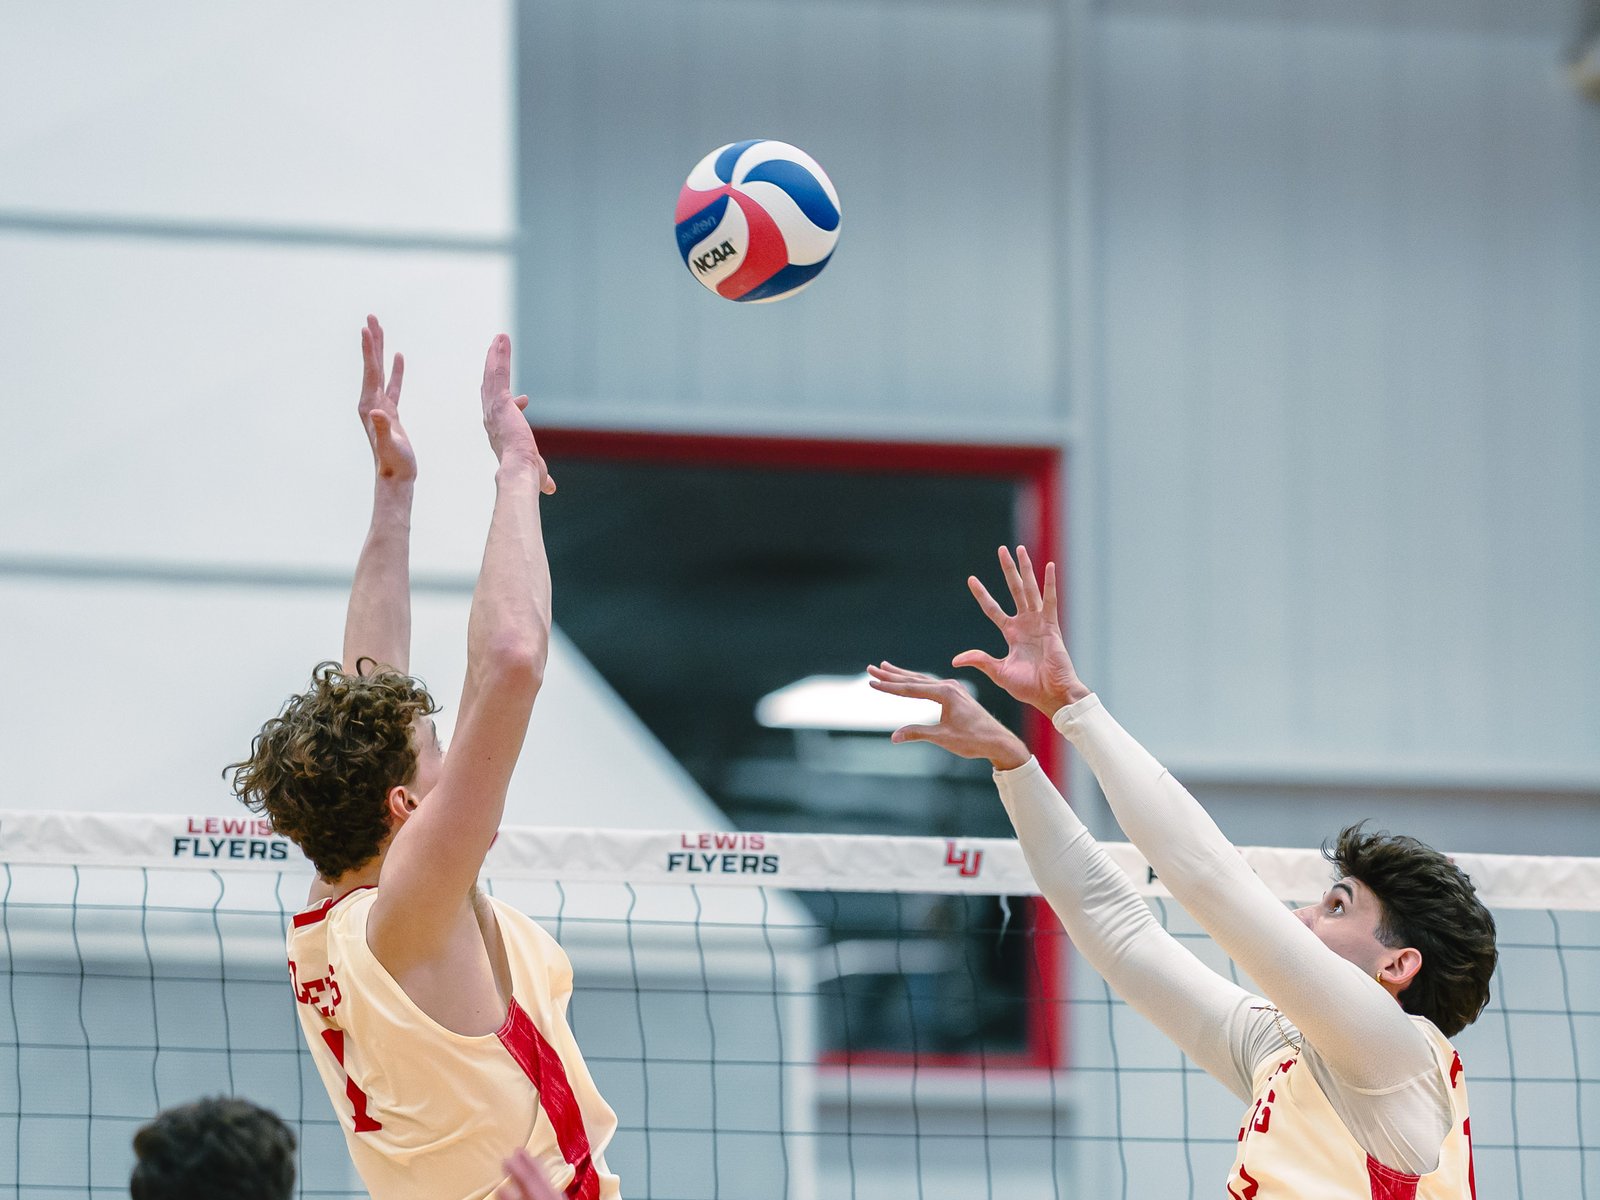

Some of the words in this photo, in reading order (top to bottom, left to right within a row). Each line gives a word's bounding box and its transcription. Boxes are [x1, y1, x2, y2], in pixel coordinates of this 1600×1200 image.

[693, 240, 737, 275] NCAA
[187, 817, 272, 836] LEWIS
[173, 838, 288, 860] FLYERS
[681, 833, 766, 850] LEWIS
[667, 853, 779, 874] FLYERS
[945, 840, 983, 877] LU
